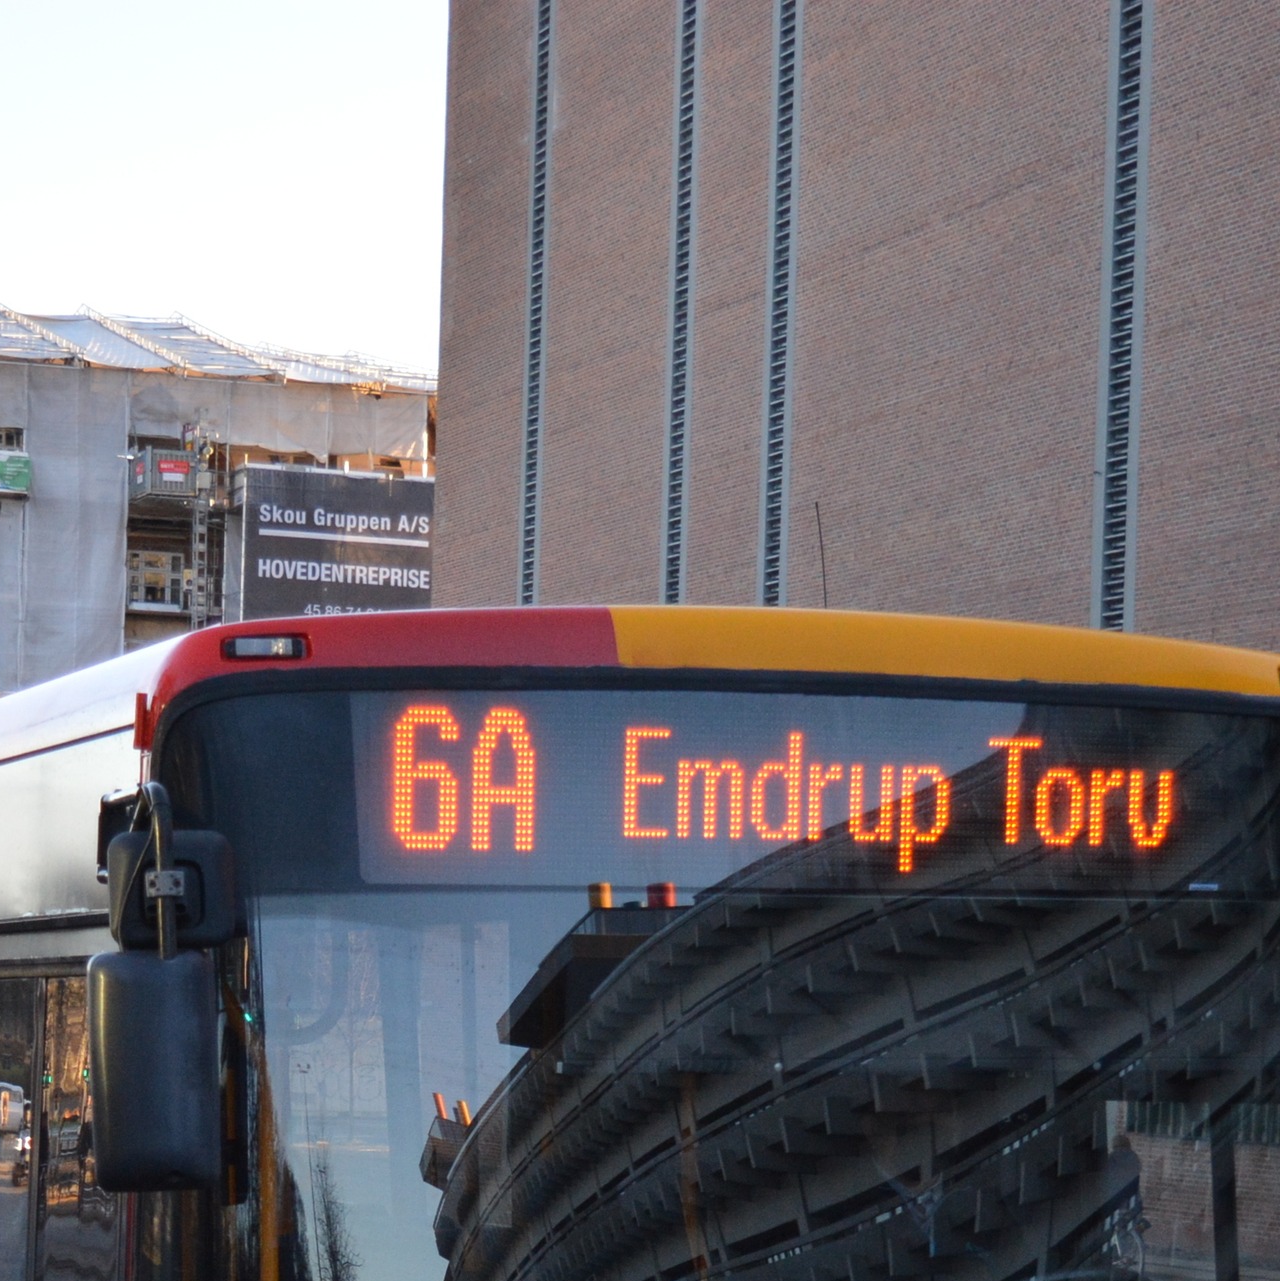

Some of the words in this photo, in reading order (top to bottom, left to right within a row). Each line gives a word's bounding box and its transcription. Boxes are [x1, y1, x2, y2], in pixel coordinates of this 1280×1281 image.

[259, 504, 307, 525] Skou
[314, 508, 391, 533] Gruppen
[397, 515, 430, 534] A/S
[257, 558, 430, 590] HOVEDENTREPRISE
[392, 705, 538, 853] 6A
[623, 730, 951, 873] Emdrup
[987, 735, 1176, 849] Torv
